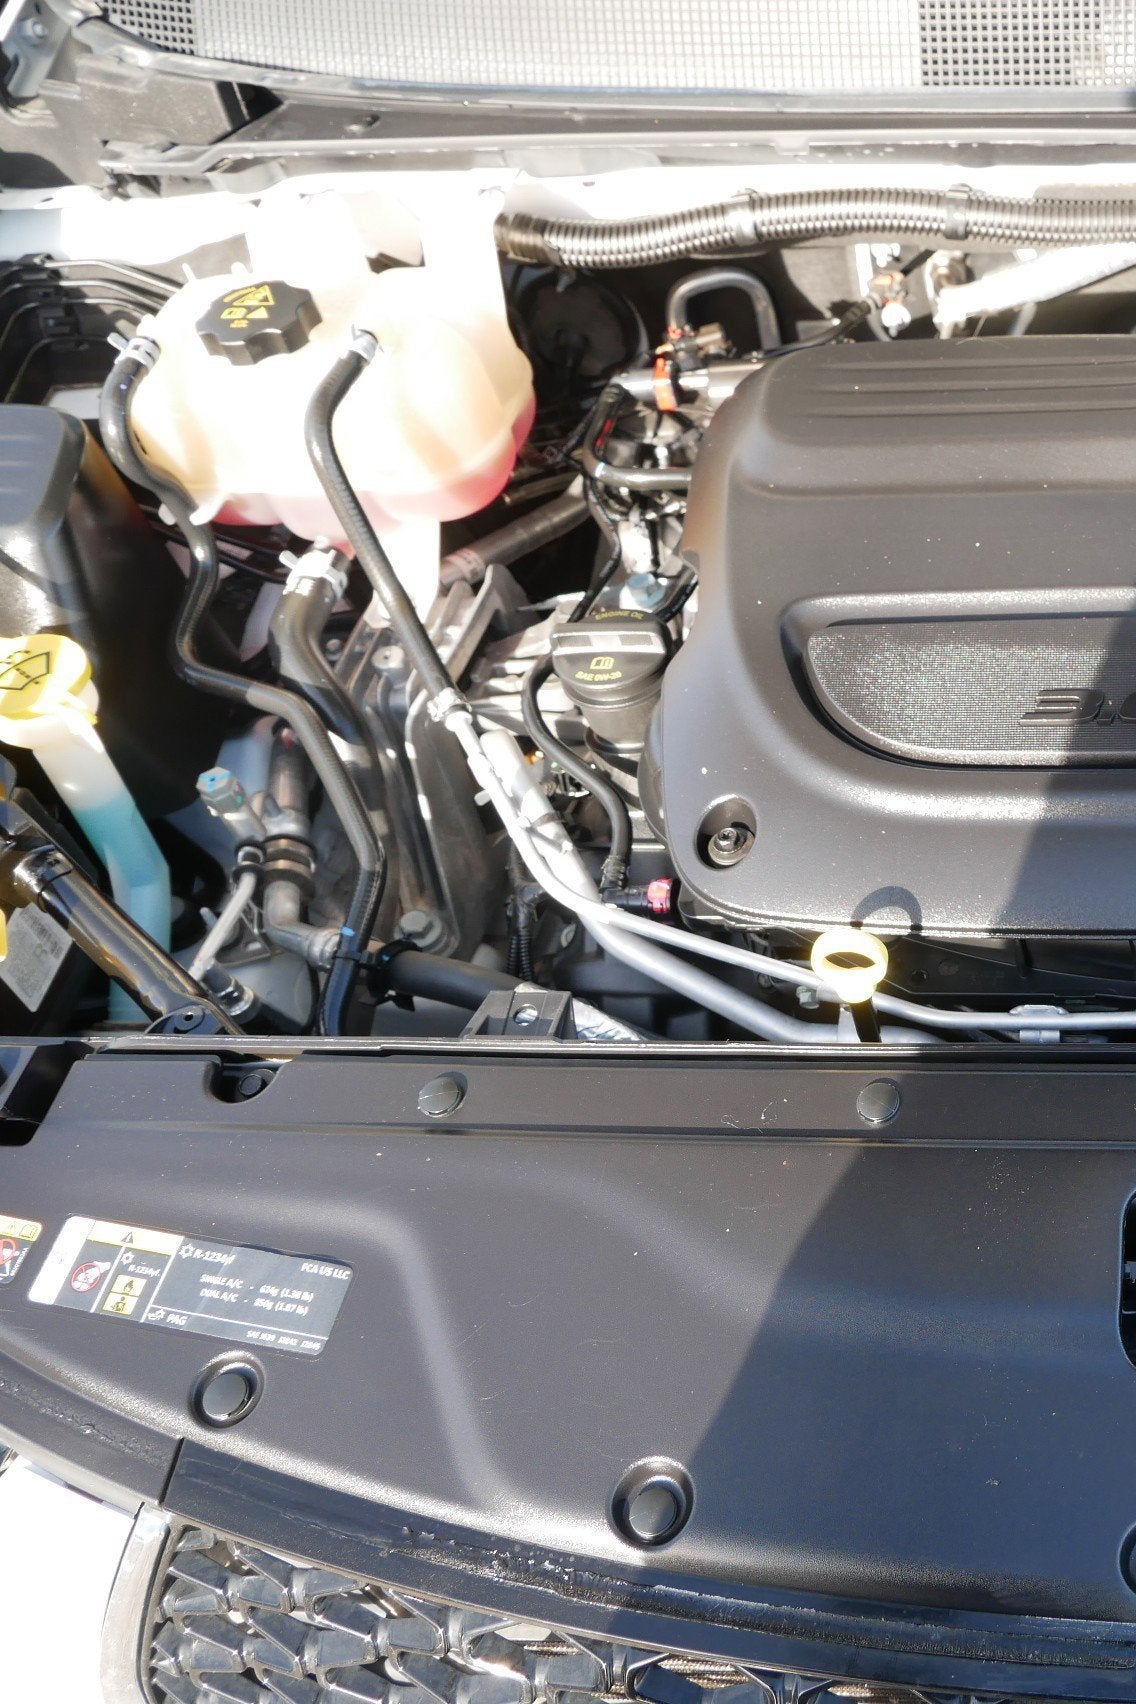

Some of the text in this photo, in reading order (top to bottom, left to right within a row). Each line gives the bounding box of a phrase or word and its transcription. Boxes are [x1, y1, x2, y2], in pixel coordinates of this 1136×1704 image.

[575, 670, 594, 681] SAE
[300, 1262, 351, 1280] FCA US LLC
[226, 1278, 244, 1289] A/C
[220, 1291, 239, 1303] A/C
[166, 1313, 188, 1326] PAG
